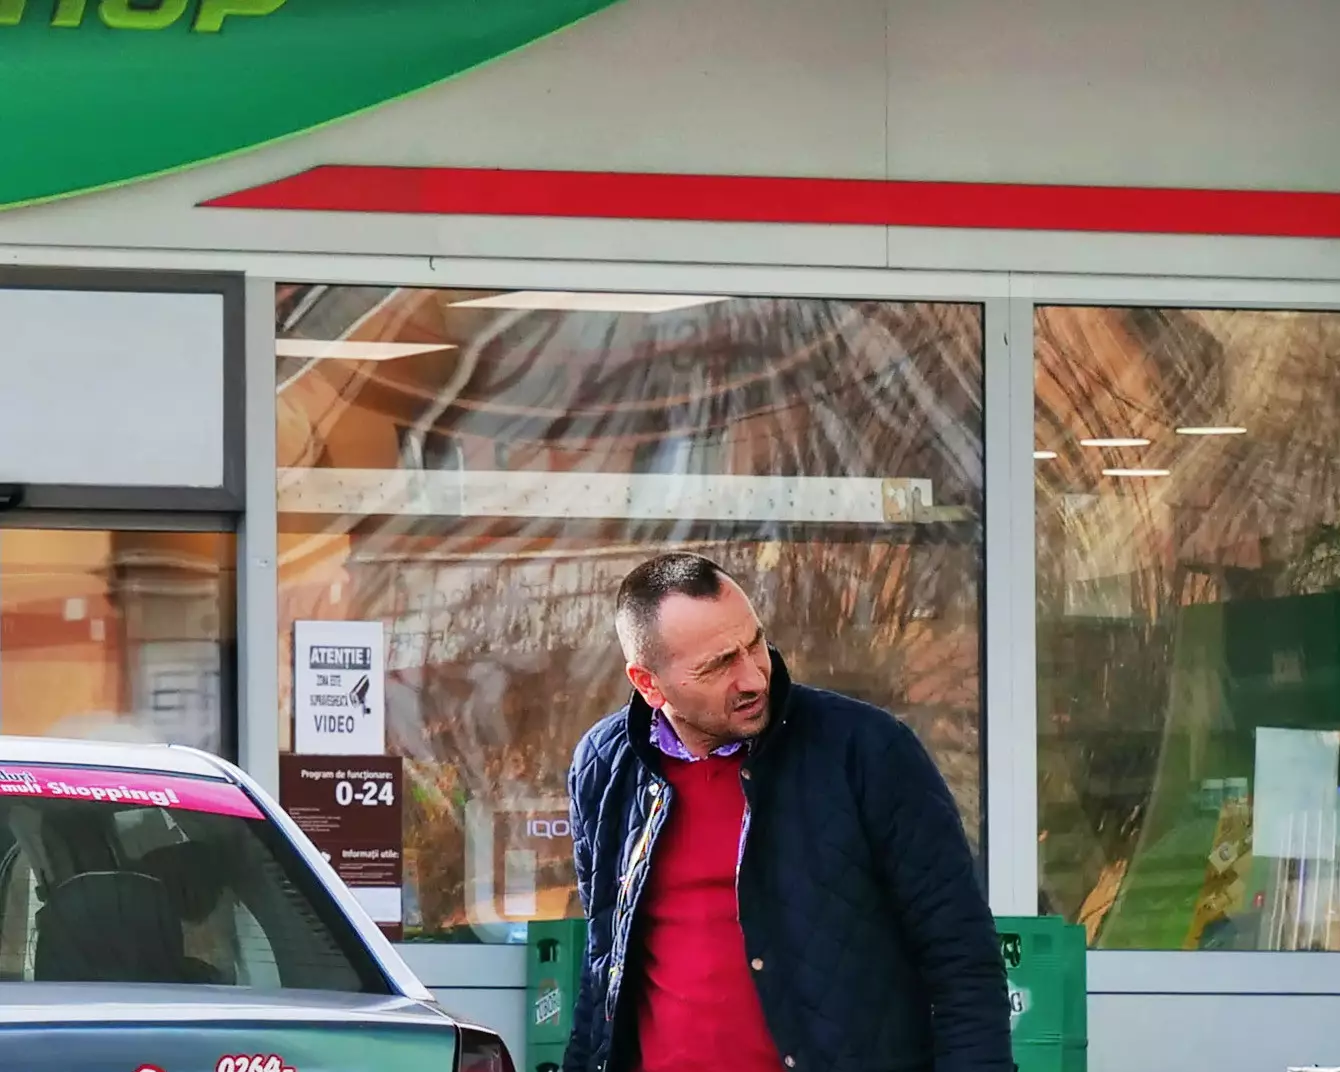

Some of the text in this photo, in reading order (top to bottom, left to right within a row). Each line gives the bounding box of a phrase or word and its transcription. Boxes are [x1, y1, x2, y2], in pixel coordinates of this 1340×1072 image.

[314, 714, 355, 734] VIDEO
[301, 769, 334, 780] Program
[335, 769, 346, 779] de
[47, 781, 181, 807] Shopping!
[335, 780, 395, 806] 0-24
[526, 819, 570, 839] IQO
